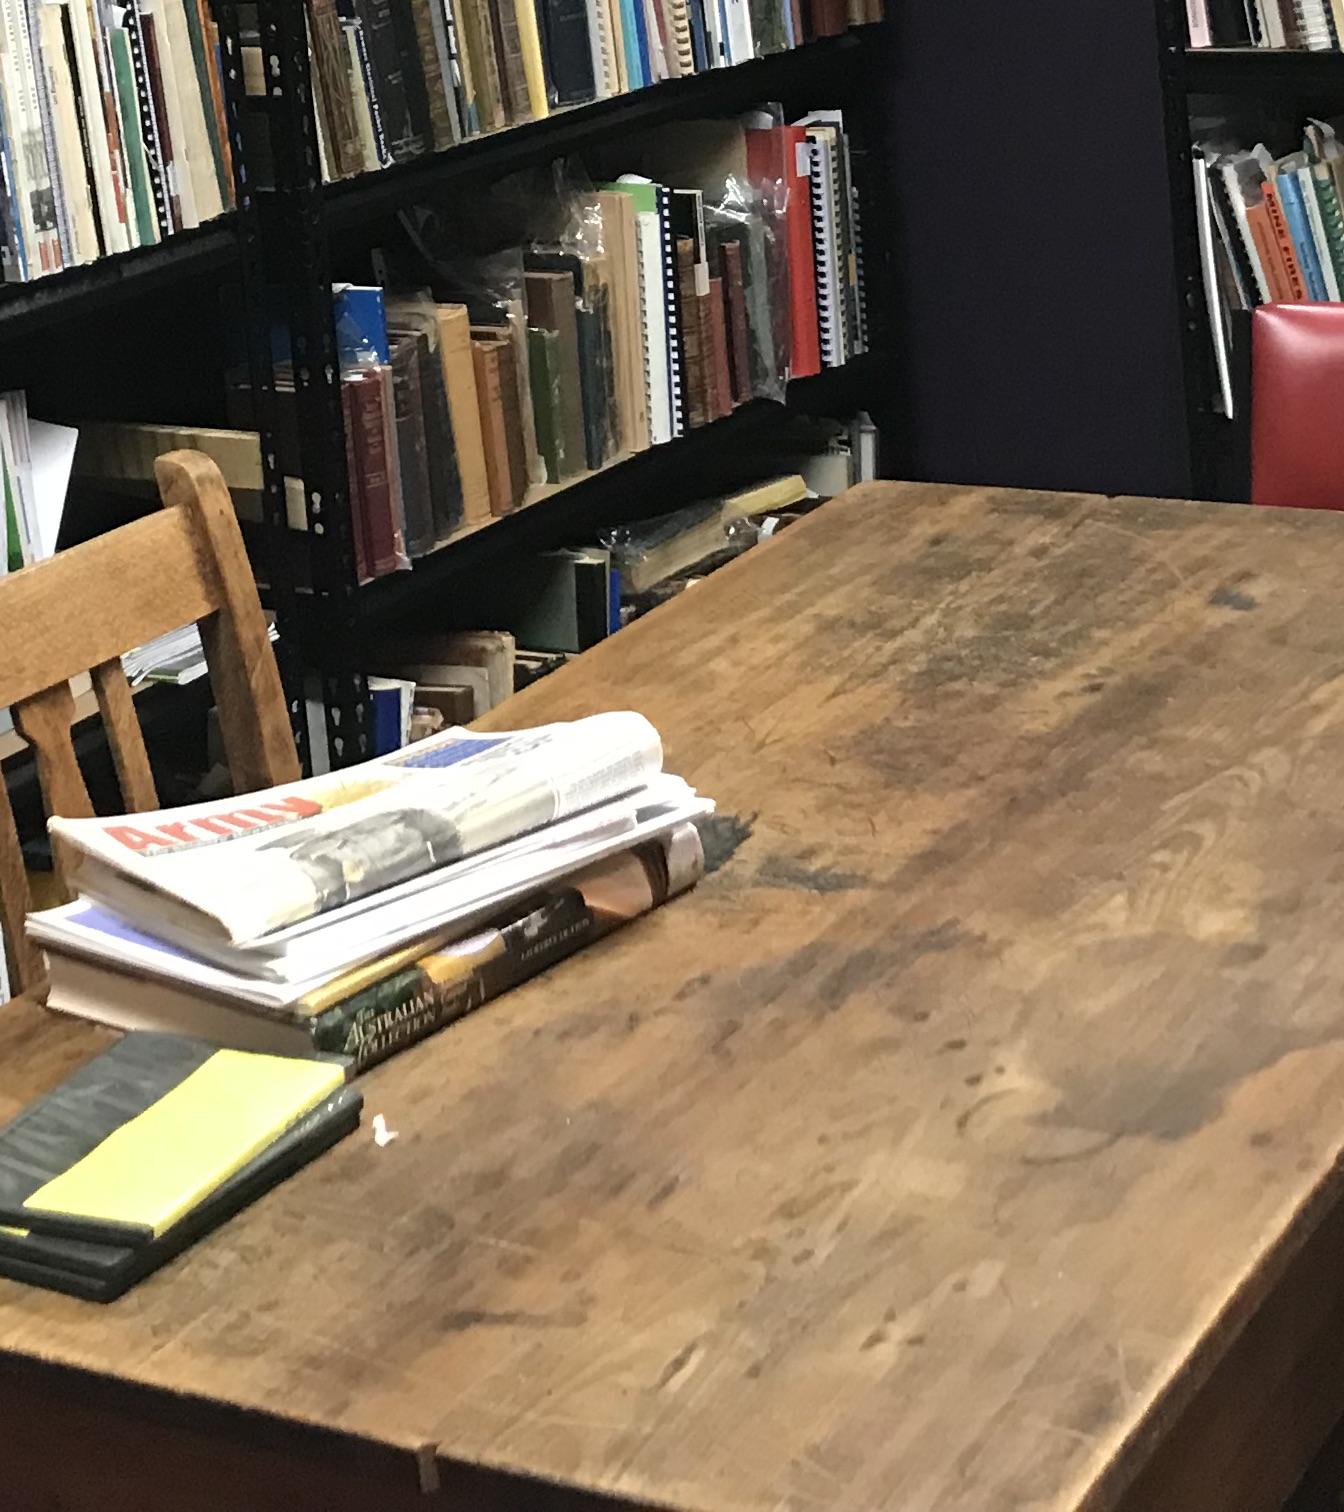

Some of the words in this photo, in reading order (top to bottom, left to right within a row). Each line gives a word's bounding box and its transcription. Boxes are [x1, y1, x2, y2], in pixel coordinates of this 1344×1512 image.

[4, 0, 16, 42] CENTURY
[1266, 193, 1287, 239] MINE
[1282, 246, 1303, 300] FIRES
[101, 796, 323, 851] Army
[343, 991, 434, 1052] AUSTRALIAN
